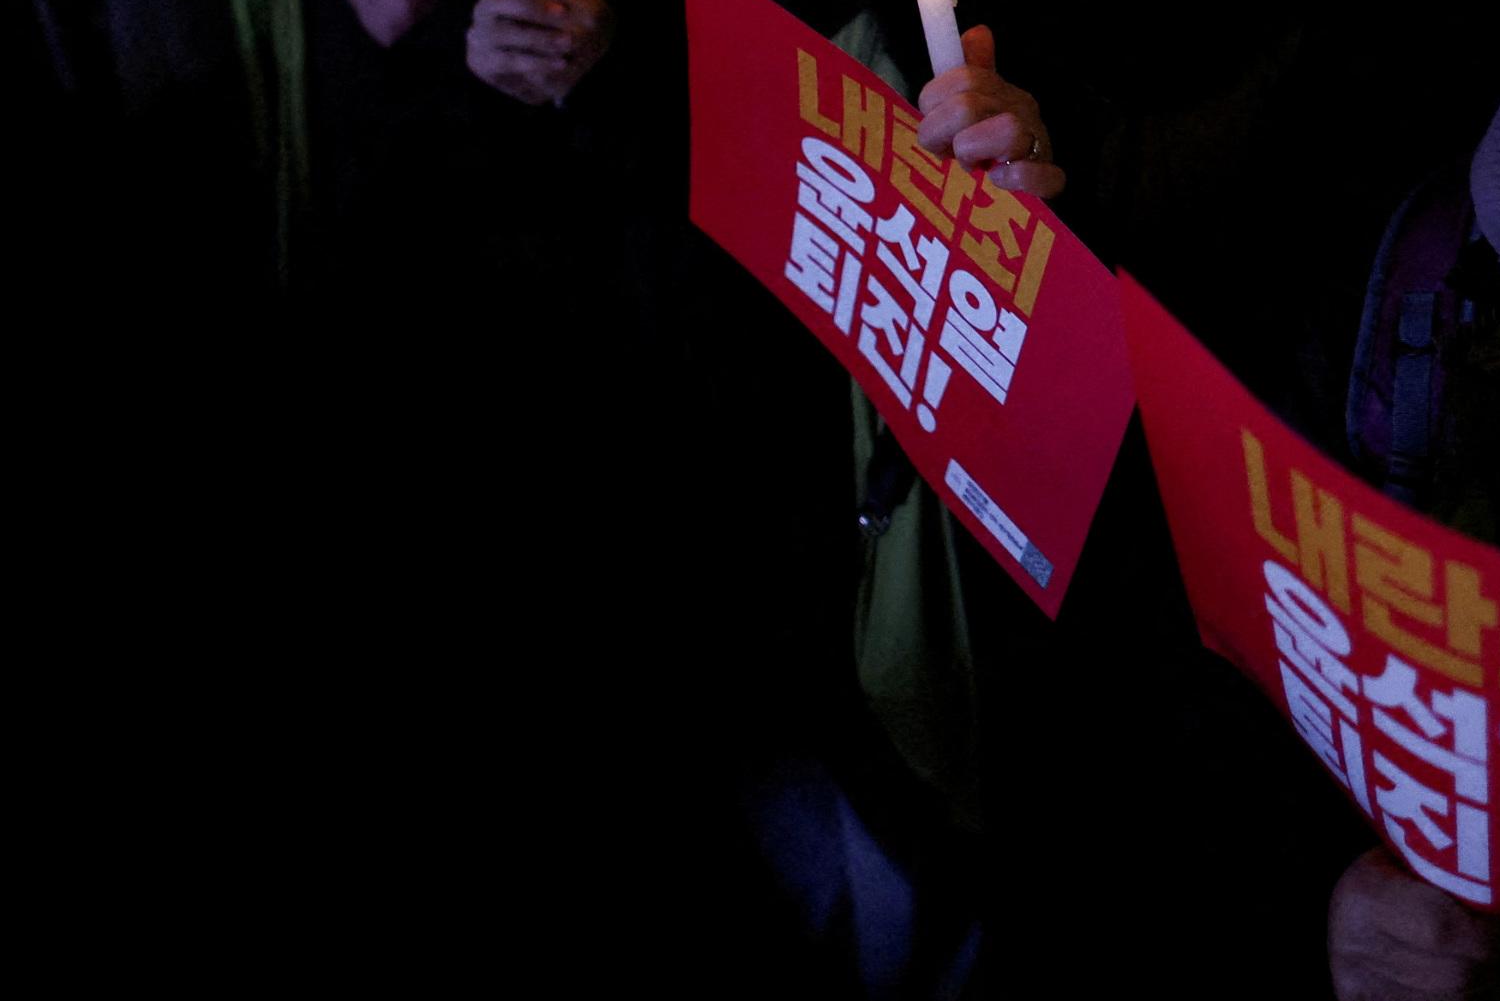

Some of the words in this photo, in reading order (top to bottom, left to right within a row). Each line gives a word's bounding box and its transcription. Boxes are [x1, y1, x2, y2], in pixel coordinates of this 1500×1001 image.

[796, 136, 1028, 406] 윤석열
[797, 47, 1056, 319] 내란죄
[784, 210, 953, 434] 퇴진!
